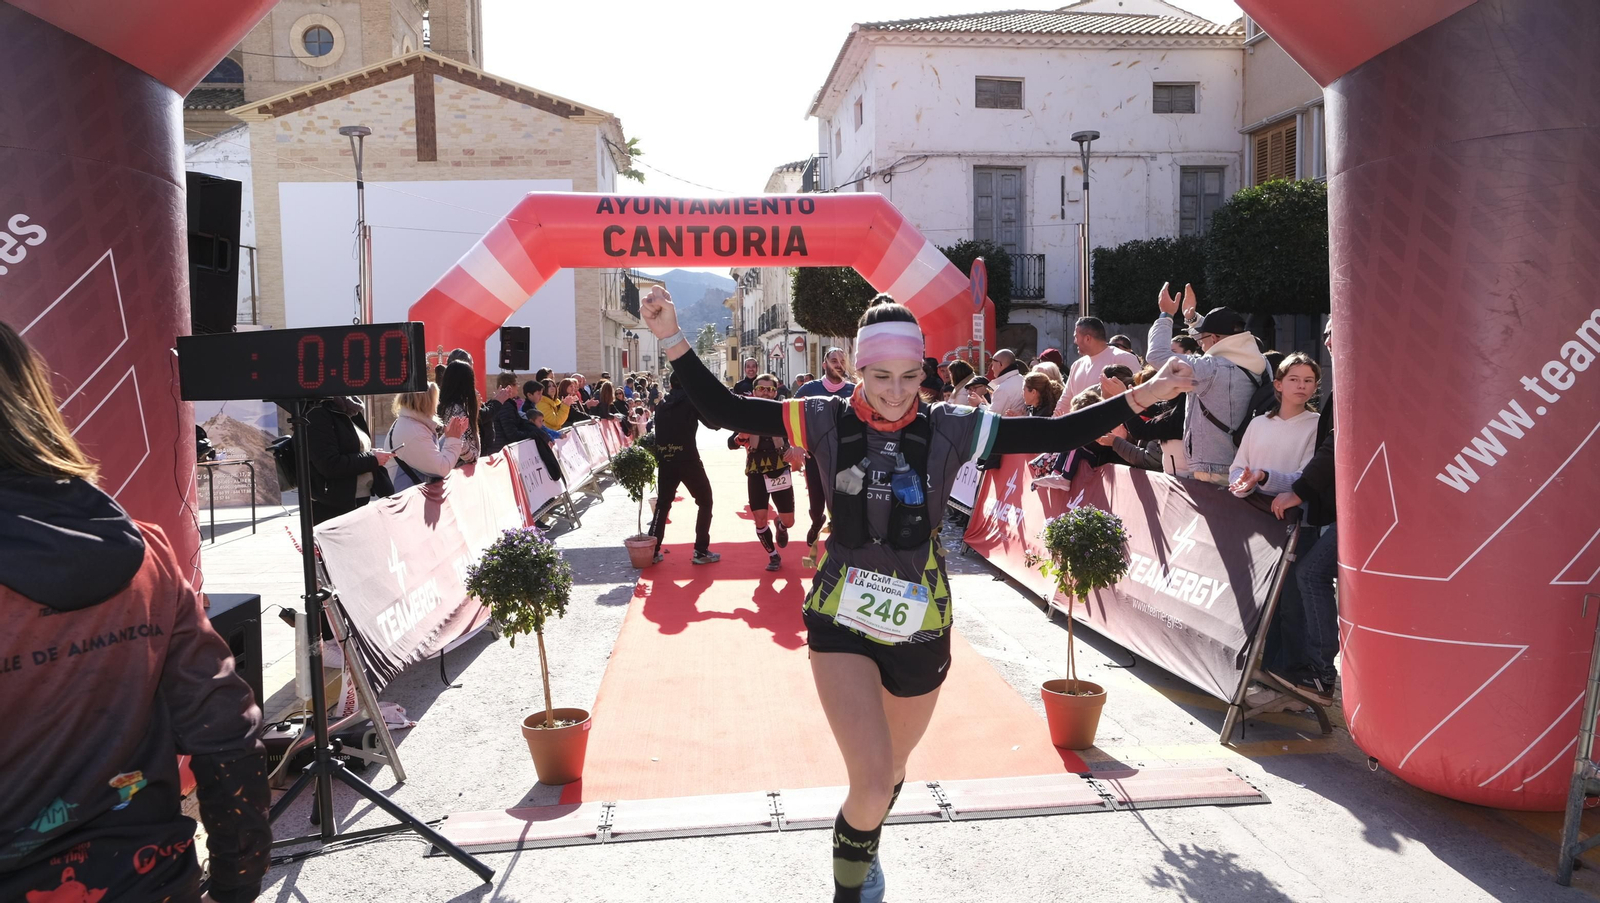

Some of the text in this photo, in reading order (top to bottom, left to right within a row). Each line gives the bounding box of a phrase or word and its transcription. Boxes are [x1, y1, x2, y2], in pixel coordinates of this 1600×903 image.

[596, 197, 815, 215] AYUNTAMIENTO
[603, 224, 808, 257] CANTORIA
[771, 476, 787, 487] 222
[854, 579, 864, 588] LA
[866, 582, 902, 597] PÓLVORA
[859, 570, 870, 579] IV
[871, 573, 891, 585] CxM
[1124, 553, 1230, 610] TEAMERGY
[377, 577, 442, 645] TEAMERGY
[856, 592, 909, 626] 246
[0, 623, 164, 673] LE DE ALMANZORA
